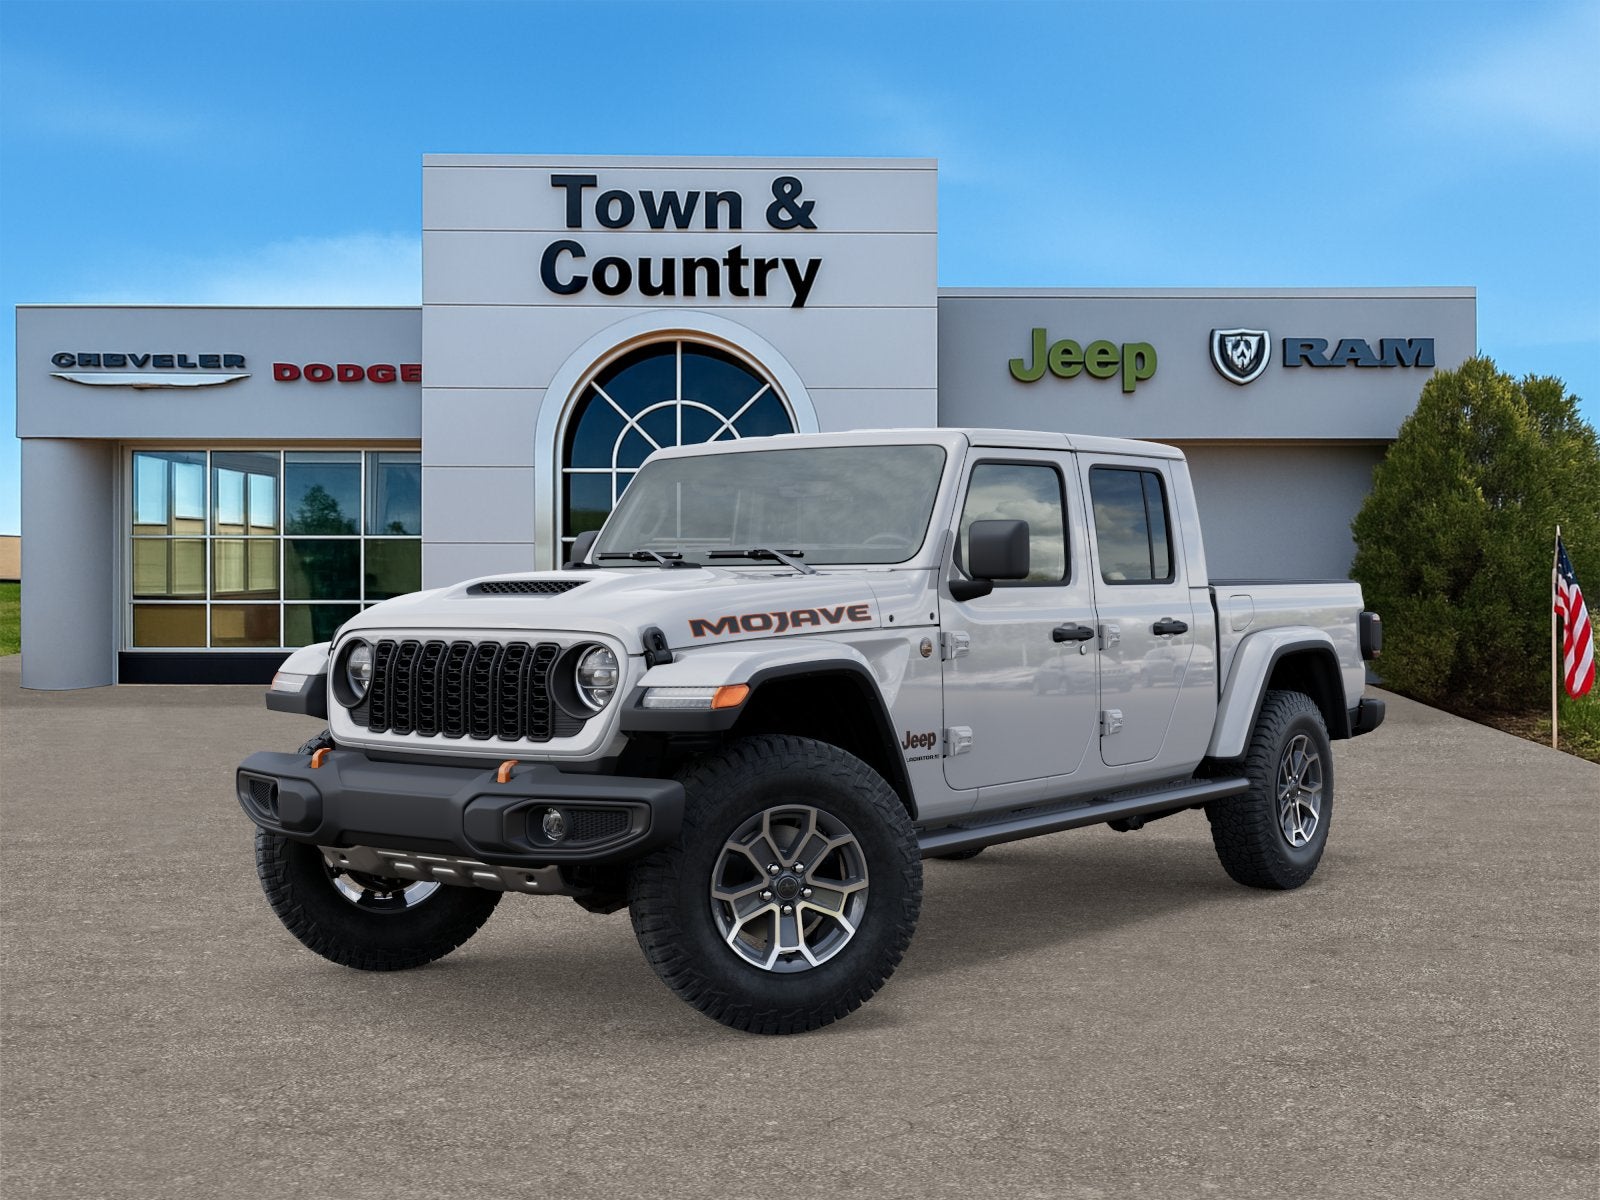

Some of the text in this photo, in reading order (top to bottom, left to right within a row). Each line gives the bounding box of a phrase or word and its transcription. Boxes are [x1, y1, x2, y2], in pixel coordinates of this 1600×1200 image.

[551, 174, 818, 230] Town &
[540, 239, 822, 308] Country
[1009, 328, 1158, 393] Jeep
[1282, 337, 1436, 368] RAM
[272, 362, 422, 383] DODGE
[688, 604, 872, 637] MOJAVE
[901, 730, 937, 751] Jeep
